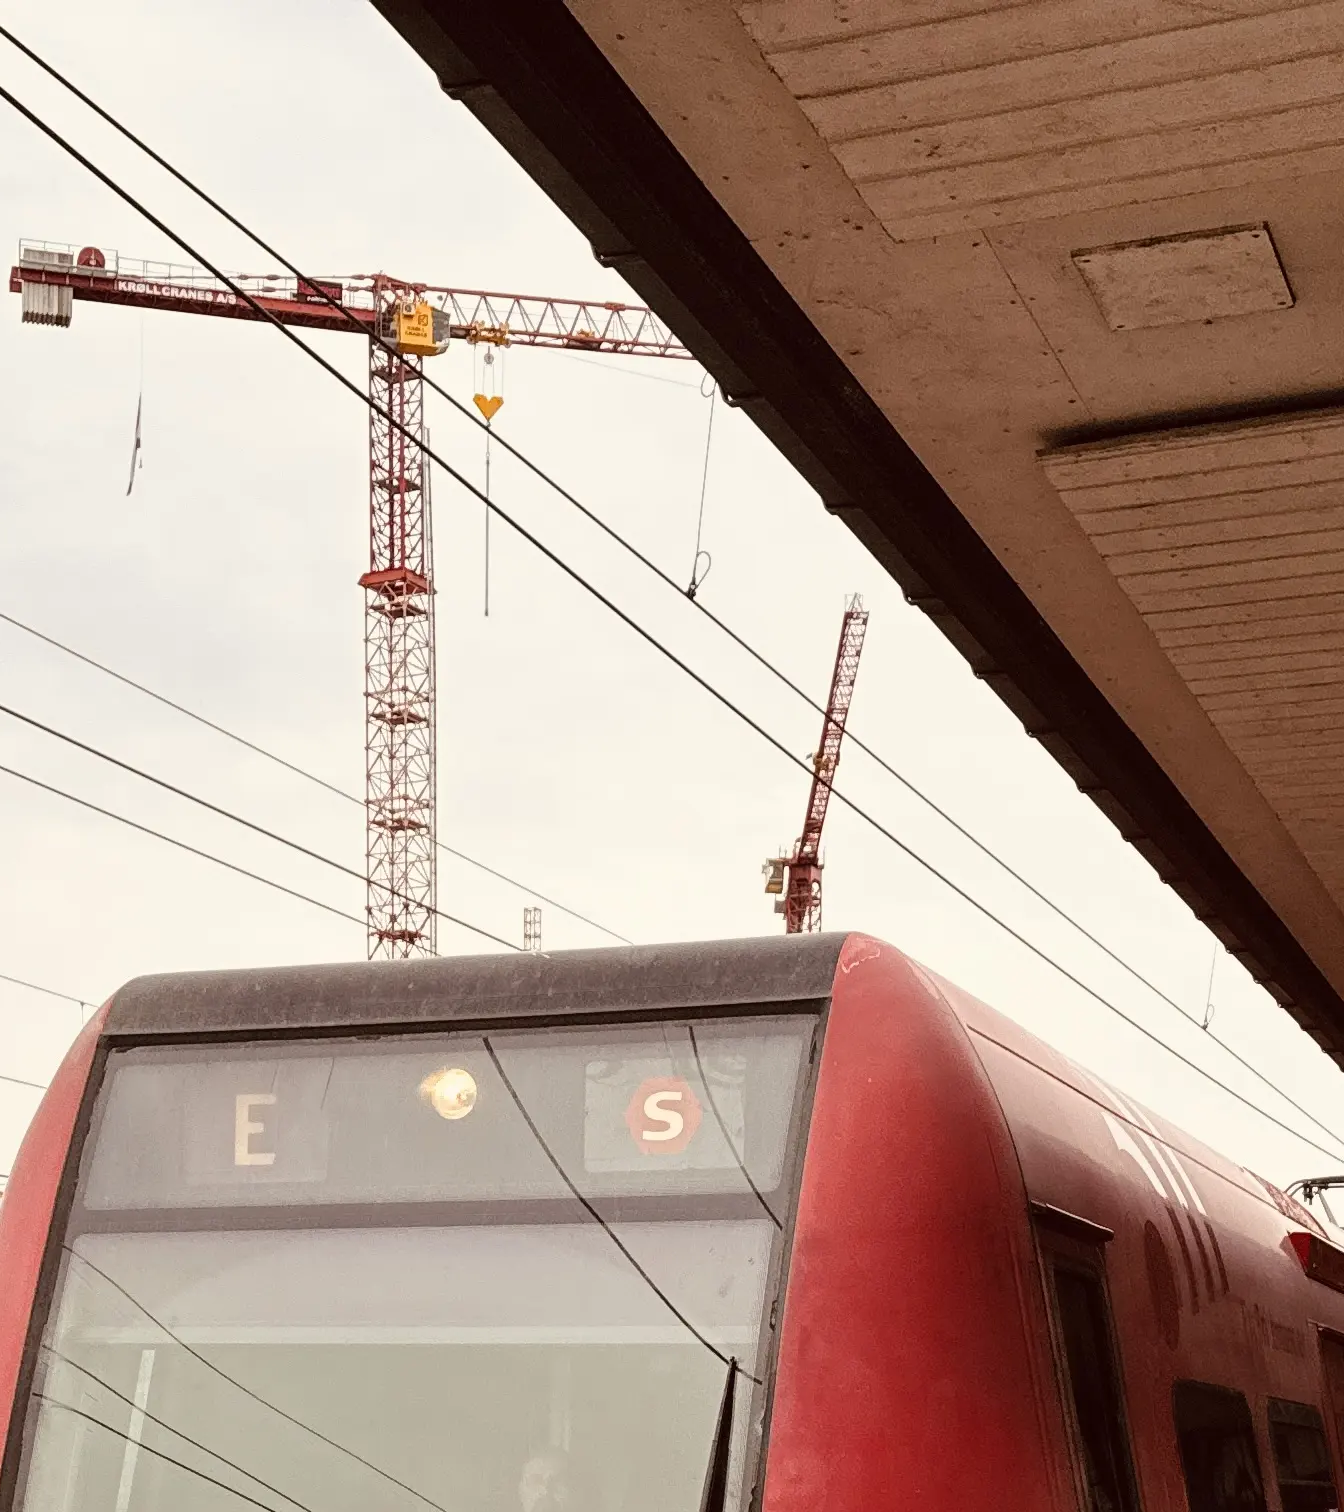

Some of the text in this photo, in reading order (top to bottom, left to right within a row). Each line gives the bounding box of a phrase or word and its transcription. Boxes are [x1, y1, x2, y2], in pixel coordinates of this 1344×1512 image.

[118, 280, 161, 296] KRØLL
[216, 293, 237, 305] A/S
[234, 1093, 277, 1166] E
[642, 1091, 684, 1141] S
